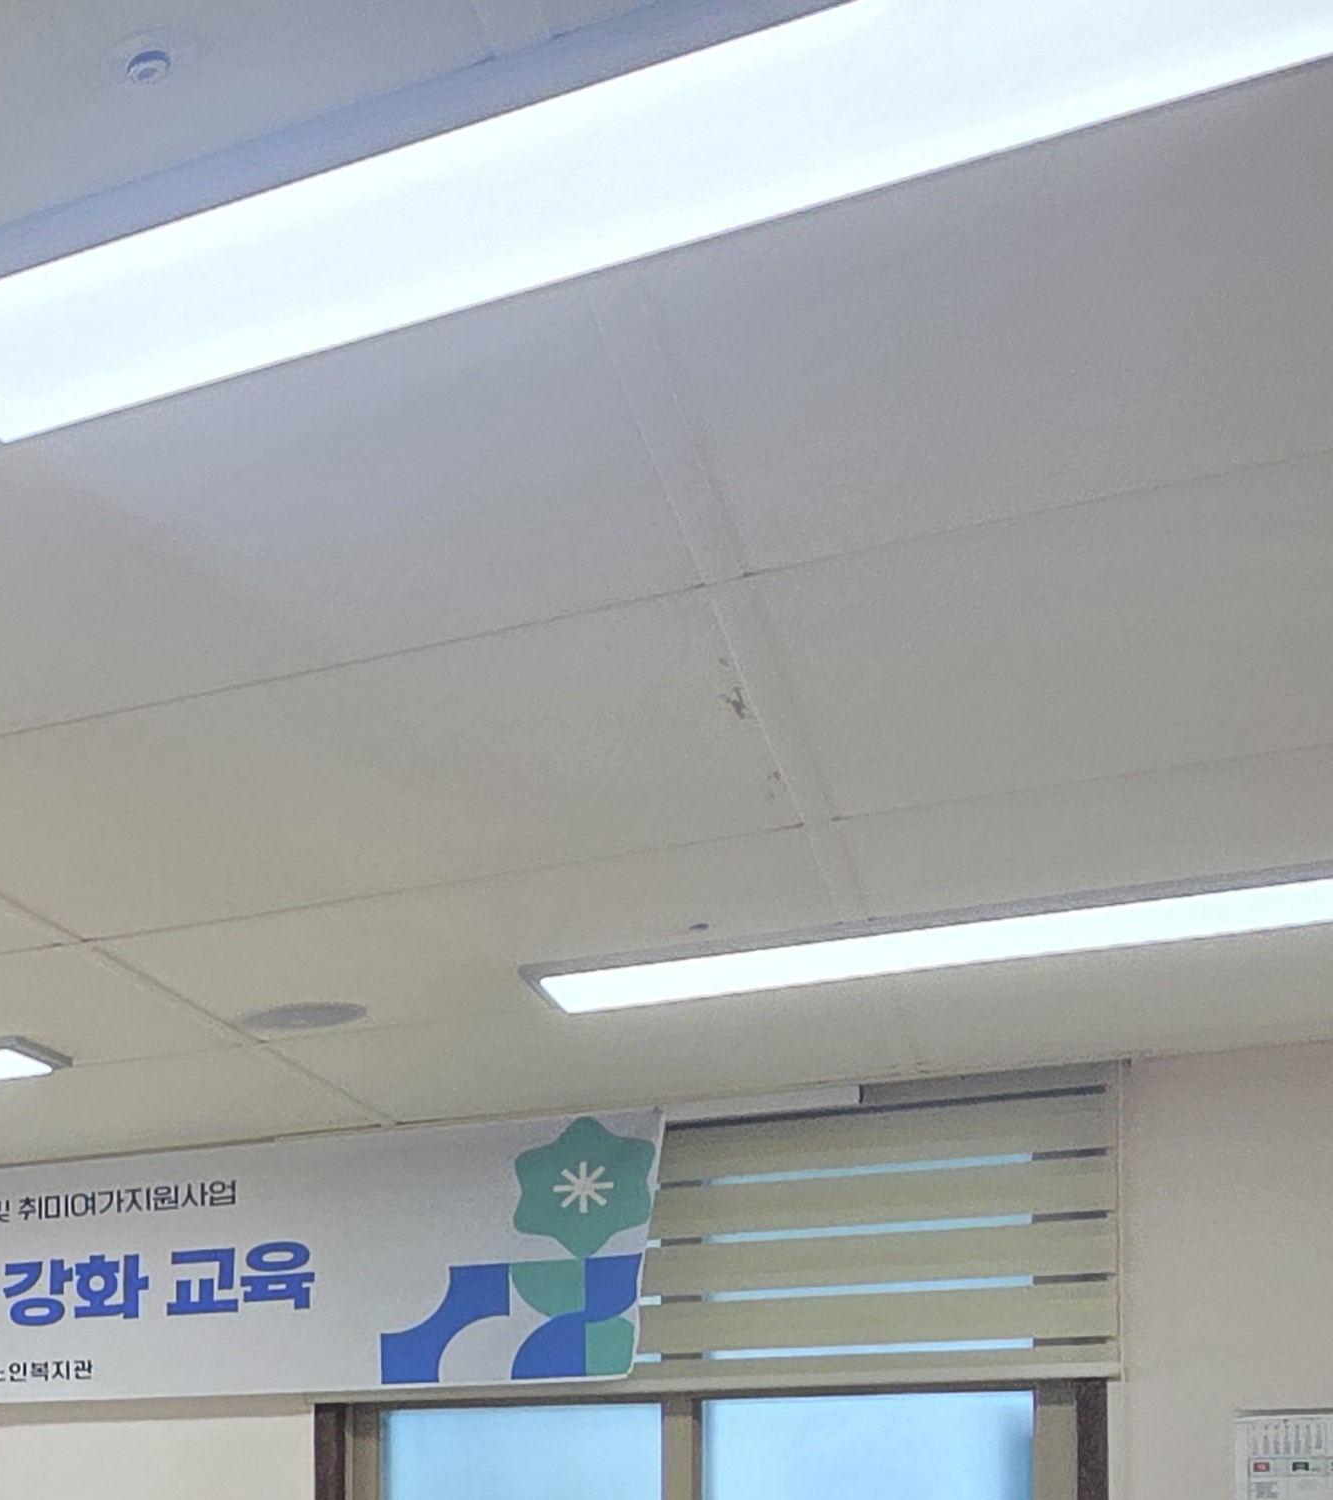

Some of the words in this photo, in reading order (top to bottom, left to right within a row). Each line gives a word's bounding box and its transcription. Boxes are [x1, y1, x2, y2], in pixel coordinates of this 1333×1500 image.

[18, 1179, 238, 1222] 취미여가지원사업
[2, 1253, 150, 1327] 강화
[165, 1240, 316, 1316] 교육
